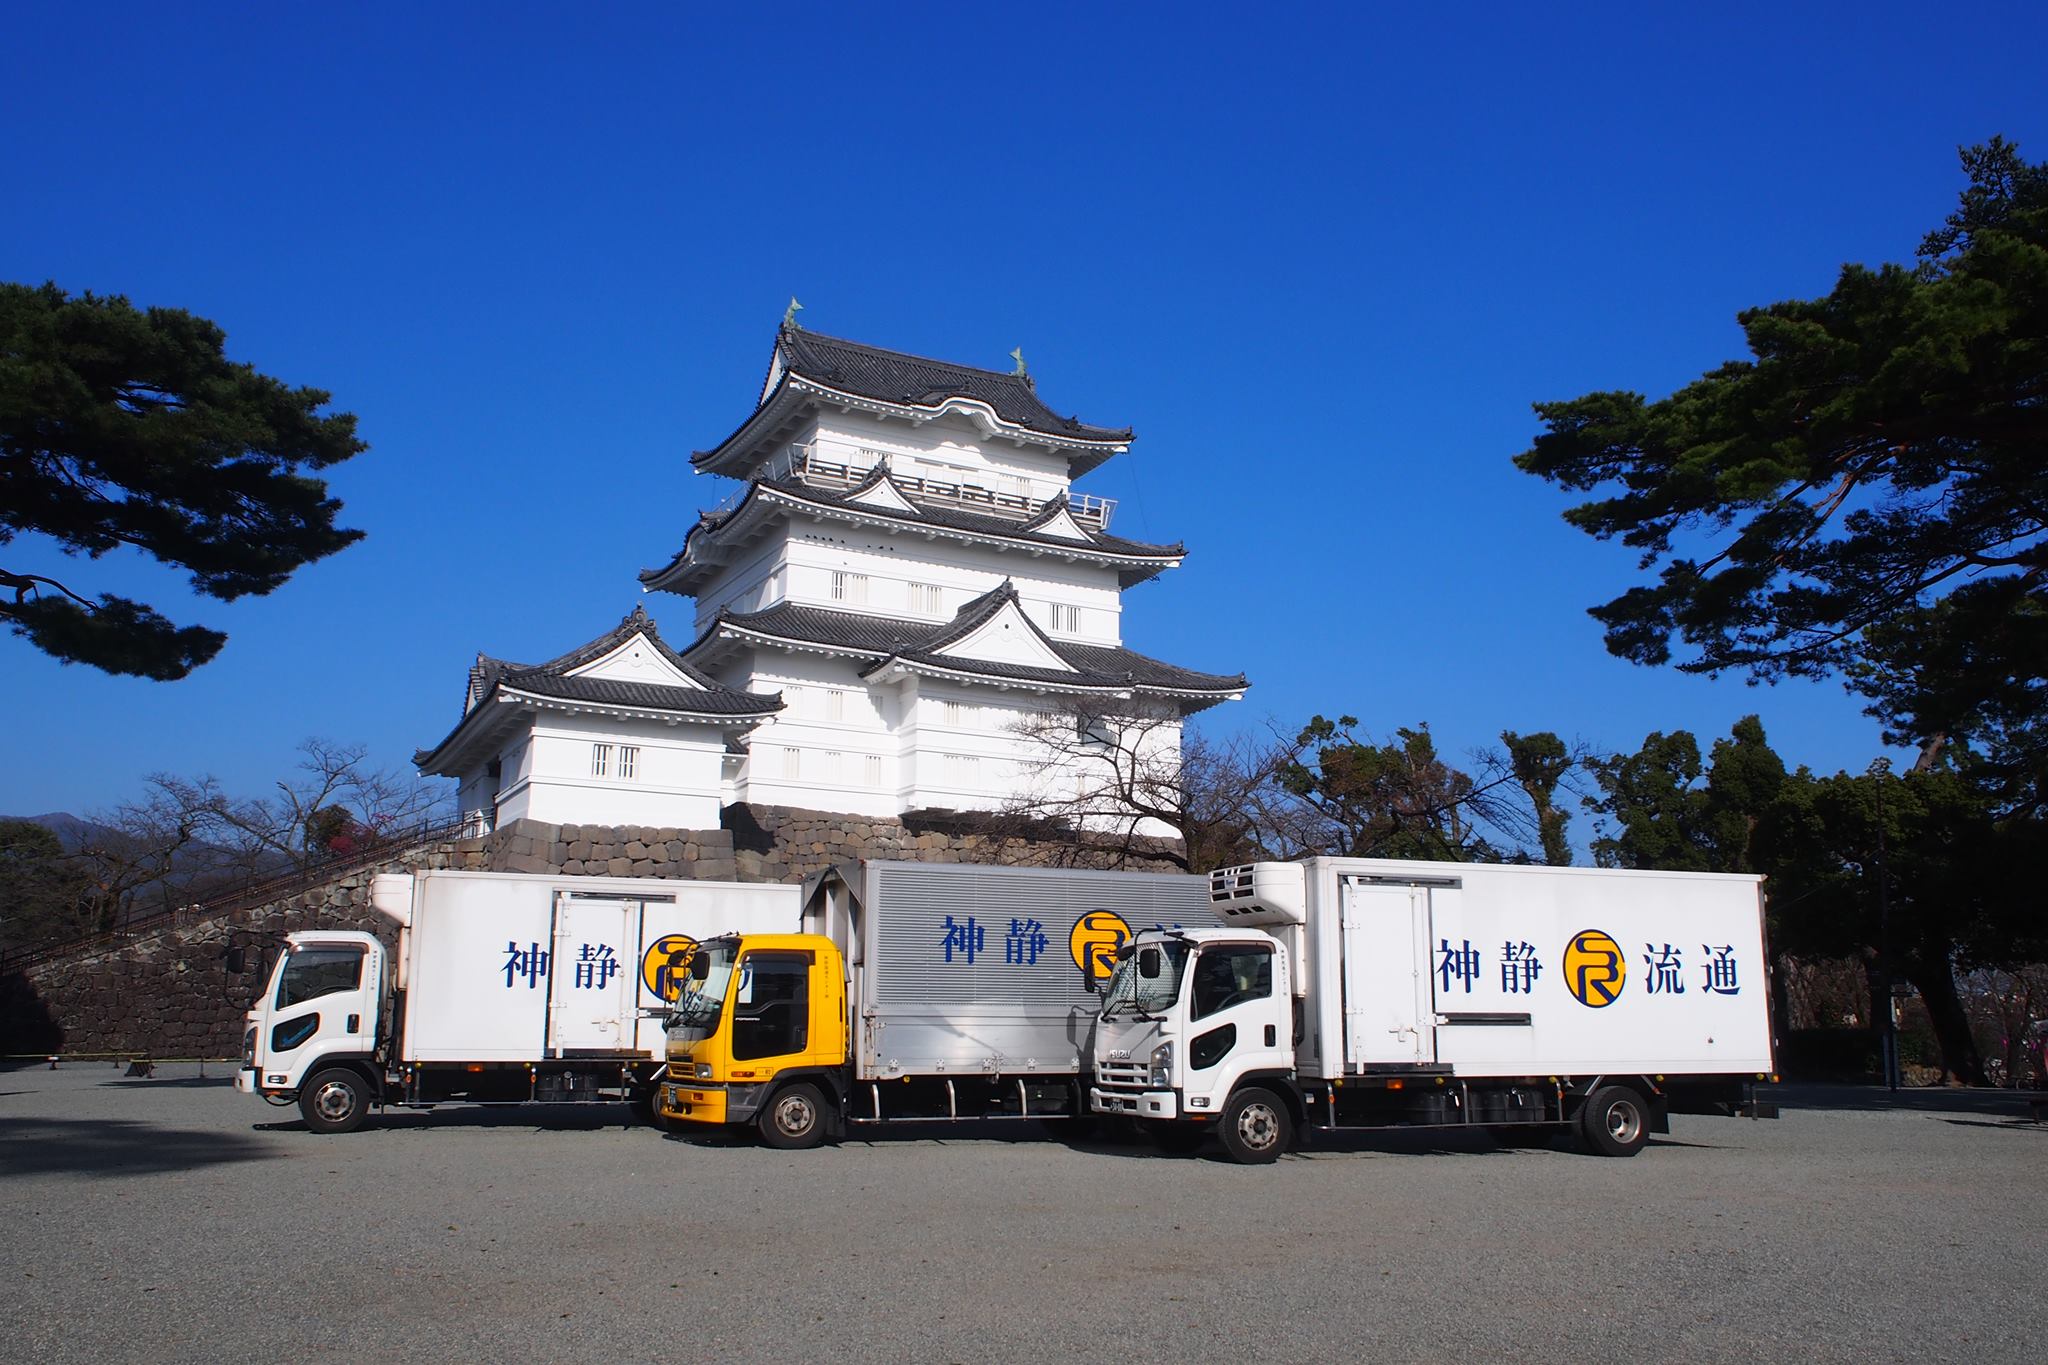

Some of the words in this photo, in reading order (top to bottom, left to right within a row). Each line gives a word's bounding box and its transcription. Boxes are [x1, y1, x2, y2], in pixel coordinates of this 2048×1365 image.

[500, 941, 621, 990] 神静
[941, 915, 1049, 967] 神静
[1436, 939, 1543, 995] 神静
[1643, 943, 1741, 996] 流通
[1110, 1049, 1131, 1060] ISUZU
